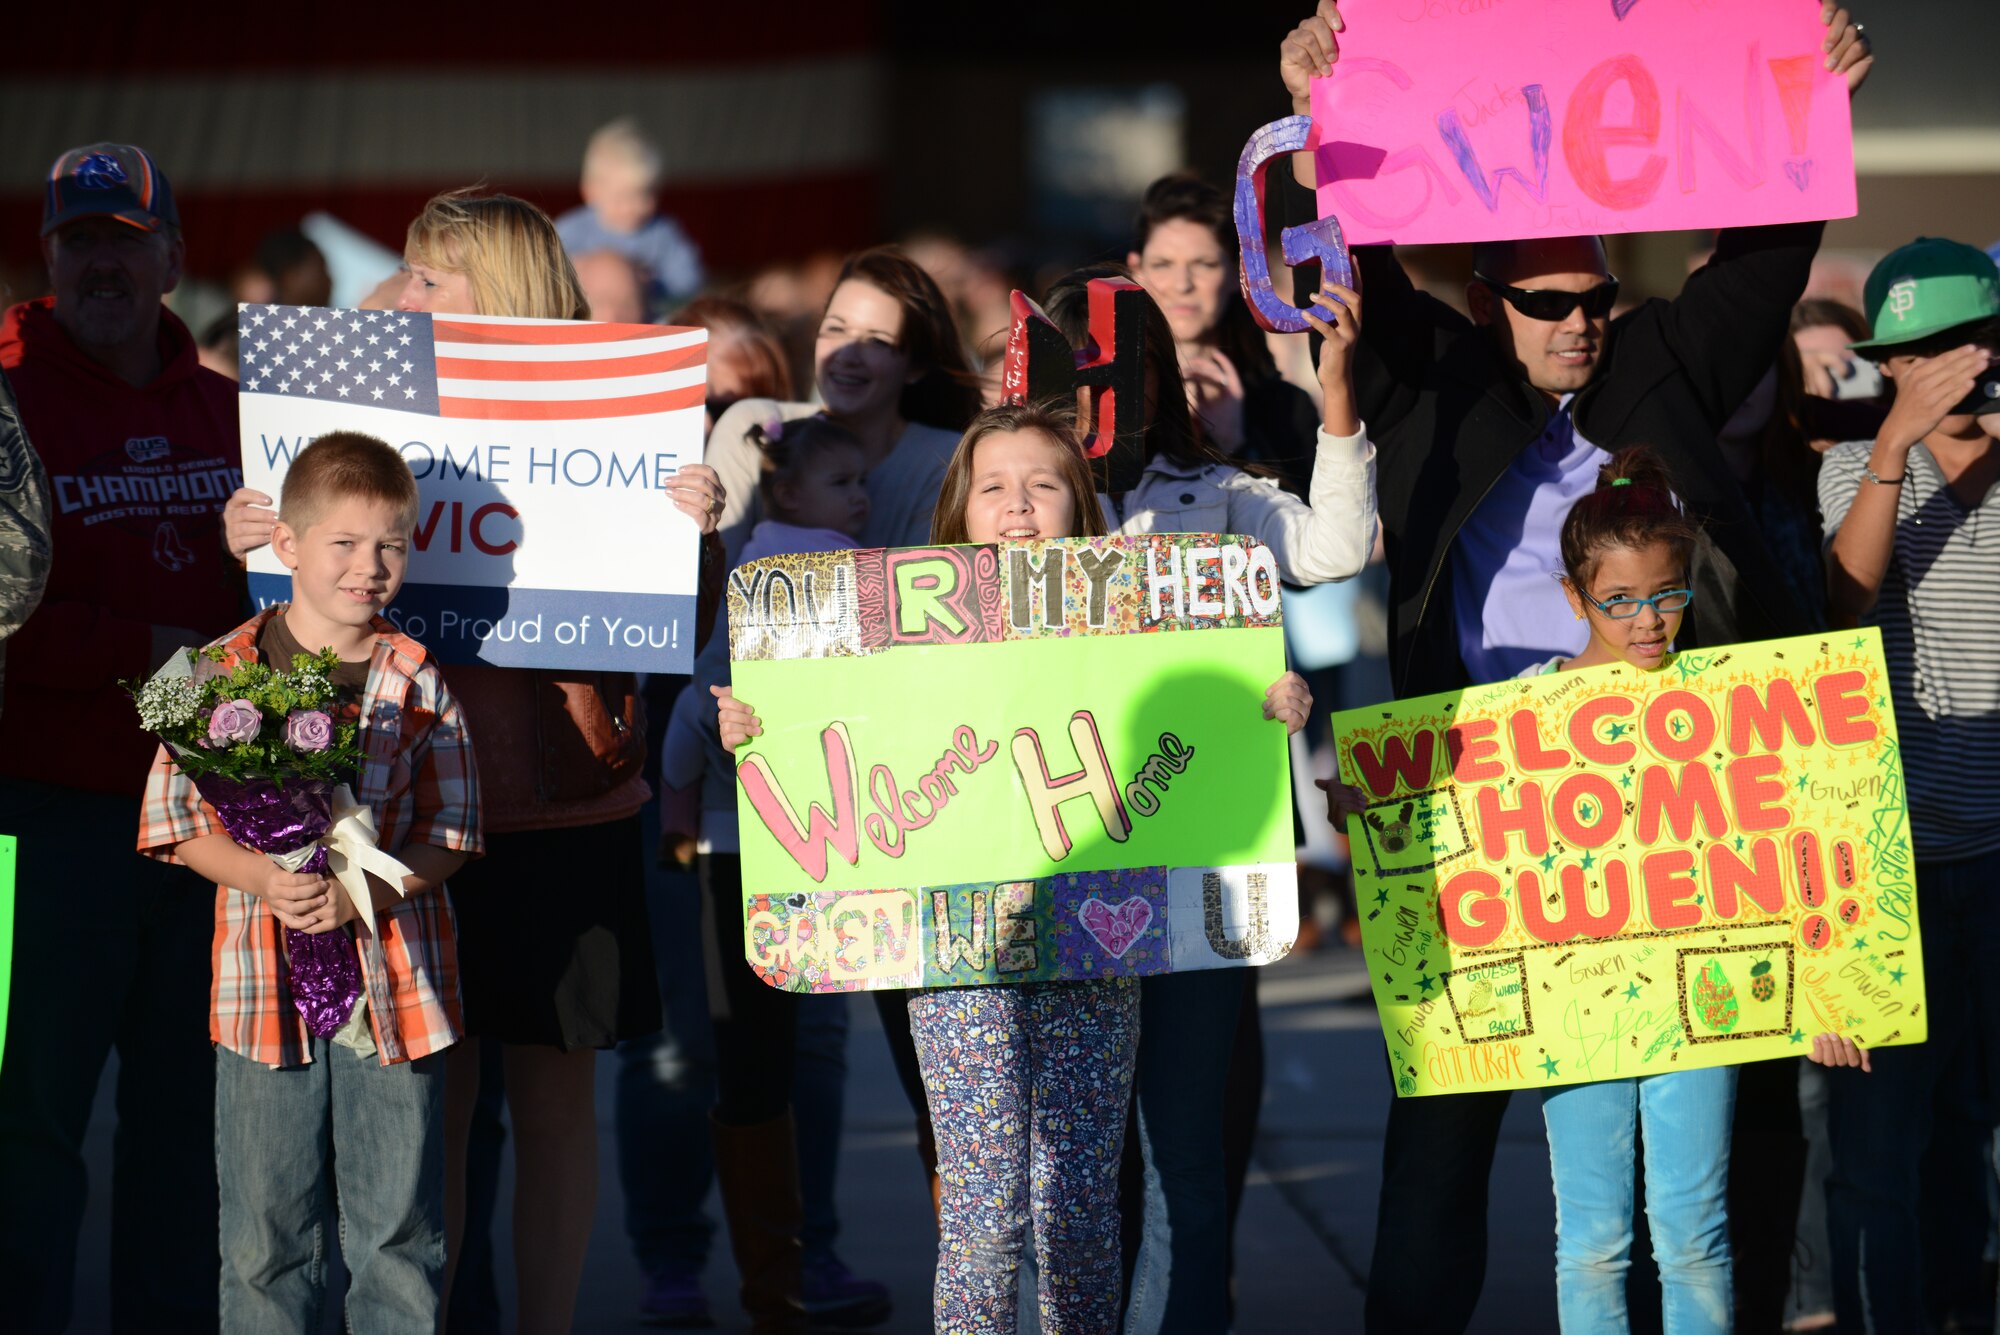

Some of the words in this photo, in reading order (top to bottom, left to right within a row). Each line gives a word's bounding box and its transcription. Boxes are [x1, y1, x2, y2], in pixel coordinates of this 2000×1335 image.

[261, 434, 510, 482] WOME
[529, 447, 677, 489] HOME
[83, 505, 160, 526] BOSTON
[166, 504, 207, 515] RED
[729, 565, 848, 641] YOU
[895, 560, 968, 636] R
[1007, 546, 1126, 629] MY
[1147, 544, 1278, 620] HERO
[388, 607, 426, 638] So
[440, 610, 542, 644] Proud
[554, 614, 592, 646] of
[601, 616, 679, 649] You!
[1351, 670, 1878, 799] WELCOME
[737, 720, 998, 882] Welcome
[1011, 709, 1194, 862] Home
[1476, 753, 1790, 862] HOME
[1810, 775, 1882, 801] Gwen
[1437, 830, 1858, 951] GWEN!!
[748, 898, 914, 974] GWEN
[931, 881, 1038, 974] WE
[1202, 871, 1269, 961] U
[1383, 905, 1419, 966] Gwen
[1466, 963, 1518, 982] GUESS
[1569, 953, 1626, 985] Gwen
[1838, 957, 1903, 1018] Gwen
[1397, 996, 1437, 1047] Gwen
[1488, 1014, 1522, 1034] BACK!
